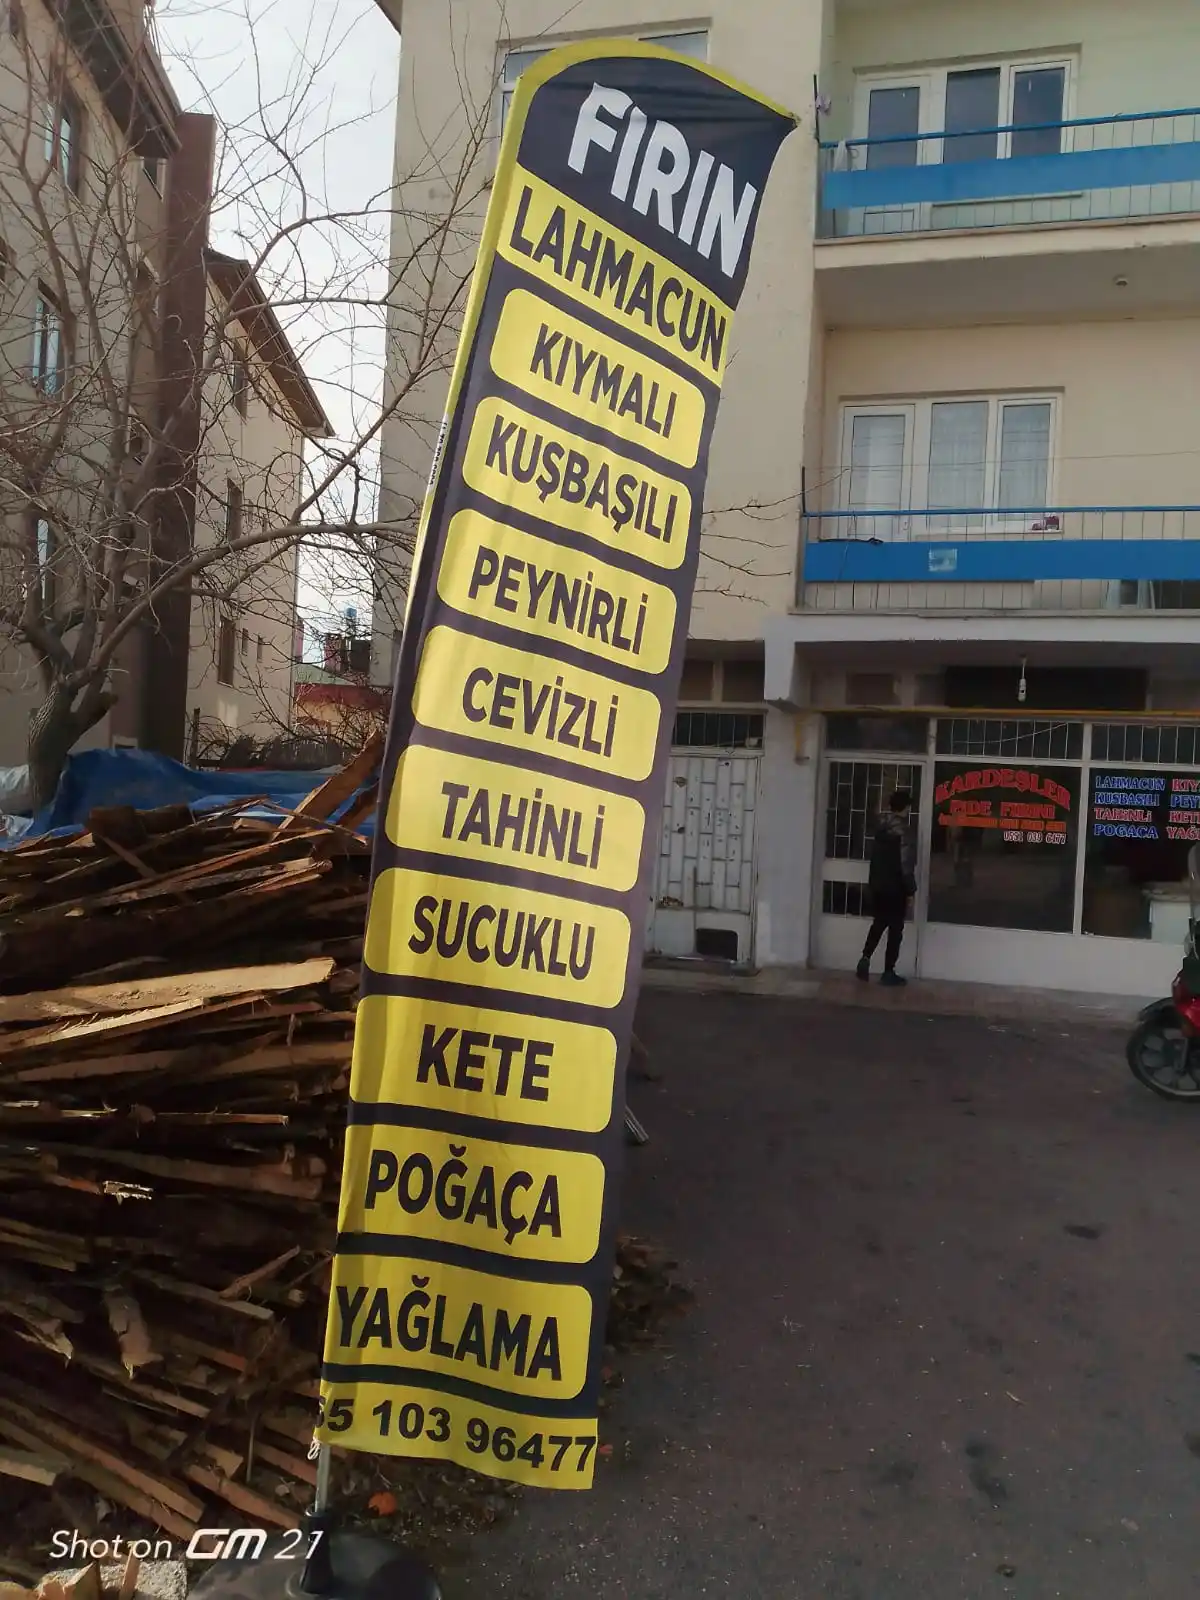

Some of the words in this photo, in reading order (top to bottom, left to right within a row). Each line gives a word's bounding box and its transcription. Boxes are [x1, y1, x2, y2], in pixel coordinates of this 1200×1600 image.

[567, 81, 758, 279] FIRIN
[509, 185, 727, 372] LAHMACUN
[529, 323, 678, 439] KIYMALI
[485, 413, 678, 544] KUŞBAŞILI
[467, 545, 649, 655] PEYNİRLİ
[462, 667, 619, 758] CEVİZLİ
[441, 781, 606, 870] TAHİNLİ
[1095, 776, 1165, 791] LAHMACUN
[1172, 778, 1200, 792] KIY
[1170, 794, 1200, 808] PEY
[408, 895, 596, 981] SUCUKLU
[416, 1023, 555, 1102] KETE
[364, 1143, 562, 1246] POĞAÇA
[335, 1274, 562, 1381] YAĞLAMA
[372, 1399, 451, 1442] 103
[465, 1418, 597, 1472] 96477
